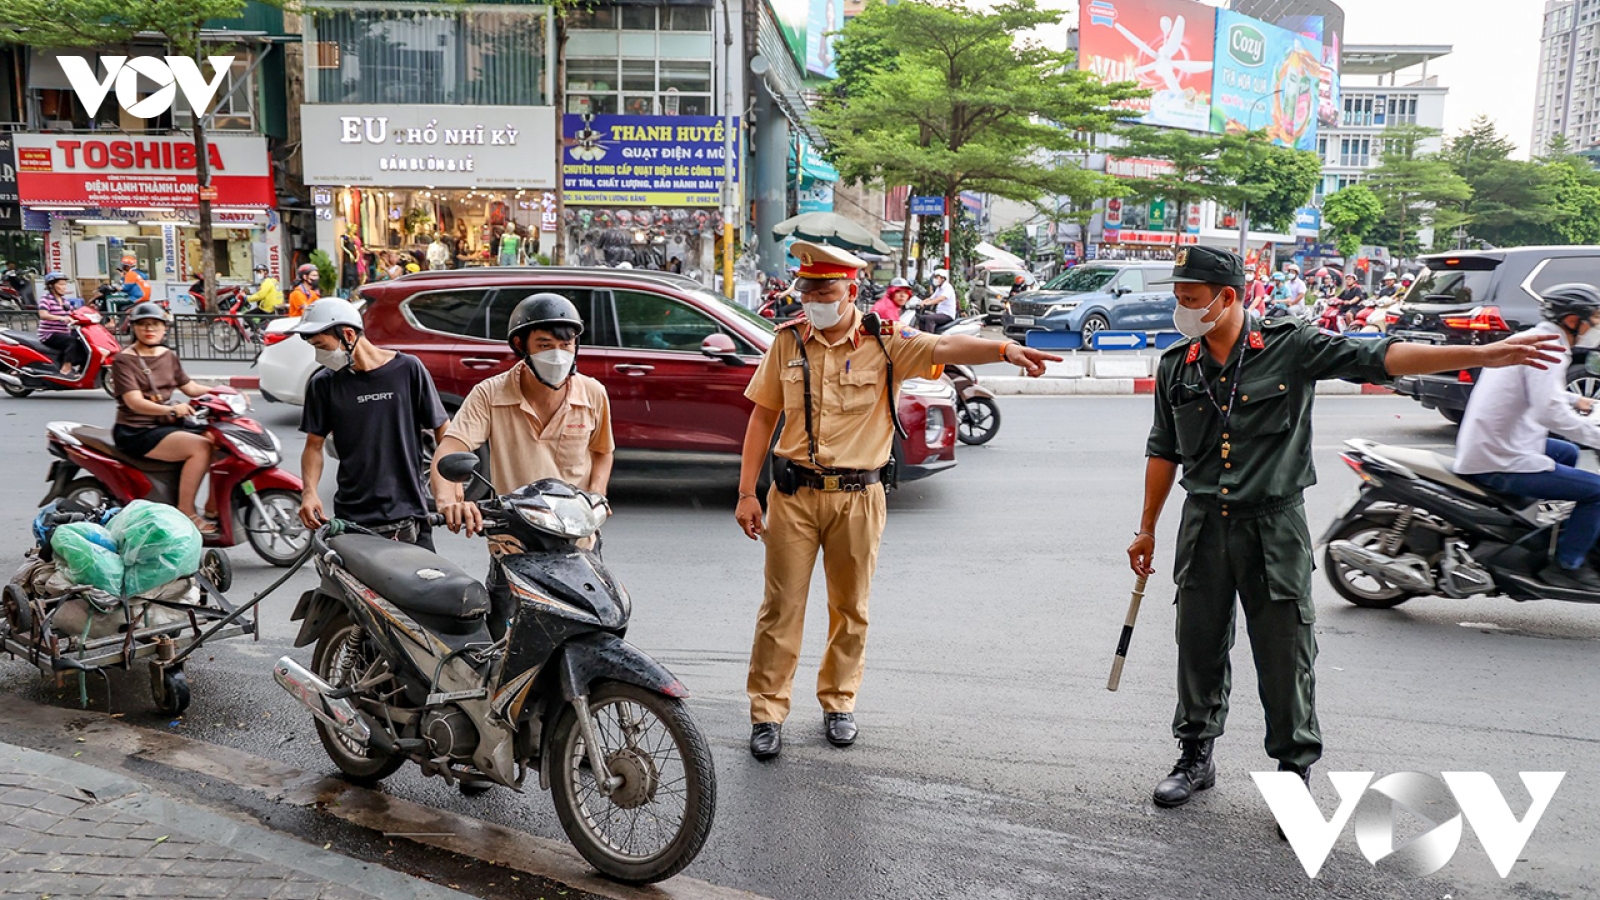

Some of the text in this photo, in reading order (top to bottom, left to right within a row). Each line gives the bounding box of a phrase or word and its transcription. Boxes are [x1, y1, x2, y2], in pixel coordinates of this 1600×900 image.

[1233, 30, 1262, 61] Cozy
[340, 116, 519, 145] EU THỔ NHĨ KỲ
[611, 125, 673, 141] THANH
[56, 140, 225, 170] TOSHIBA
[621, 147, 658, 161] QUẠT
[661, 146, 692, 162] ĐIỆN
[694, 148, 704, 159] 4
[379, 154, 408, 171] BÁN
[410, 154, 446, 171] BUÔN
[447, 158, 457, 171] &
[563, 162, 593, 175] CHUYÊN
[594, 165, 616, 175] CUNG
[617, 162, 632, 175] CẤP
[634, 165, 653, 177] QUẠT
[674, 164, 690, 176] CÁC
[84, 179, 110, 194] ĐIỆN
[110, 181, 138, 194] LẠNH
[138, 181, 174, 193] THÀNH
[564, 178, 577, 187] UY
[597, 177, 620, 188] CHẤT
[653, 178, 671, 189] BẢO
[673, 179, 697, 189] HÀNH
[699, 179, 714, 189] DÀI
[314, 194, 331, 204] EU
[541, 212, 557, 222] EU
[356, 392, 394, 404] SPORT
